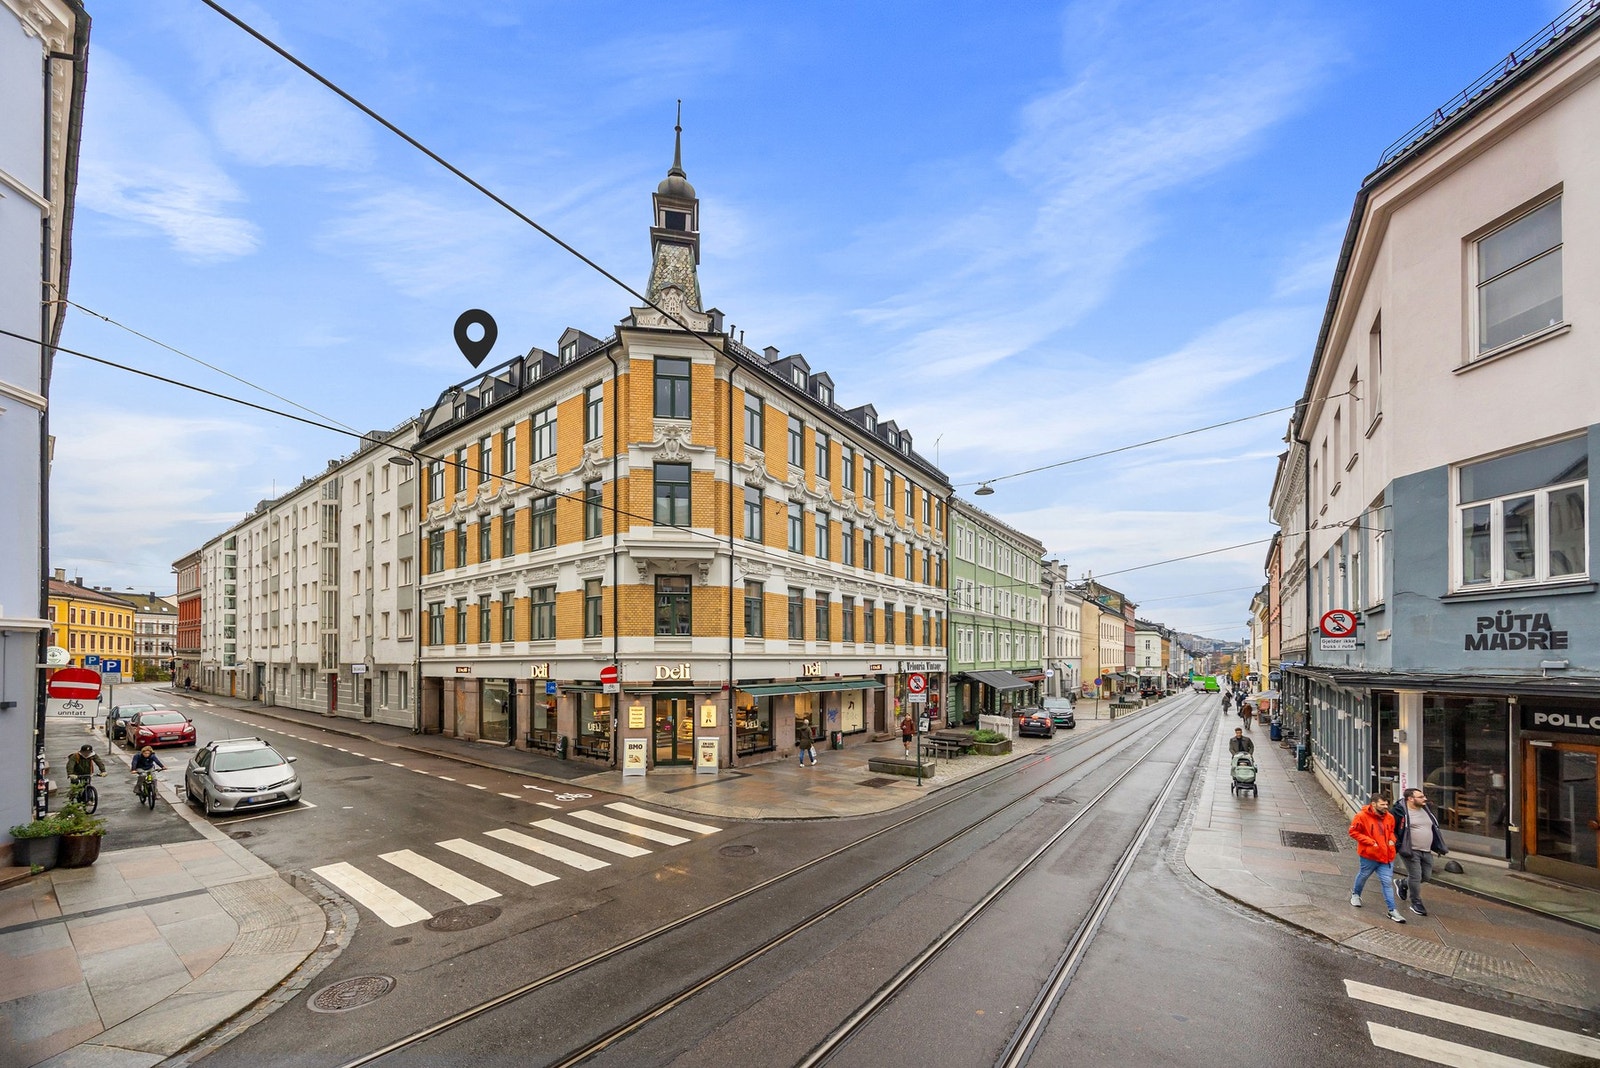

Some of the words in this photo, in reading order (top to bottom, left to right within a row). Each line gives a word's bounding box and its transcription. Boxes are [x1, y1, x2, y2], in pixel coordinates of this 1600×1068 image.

[1477, 609, 1552, 633] PÜTA
[1464, 631, 1568, 651] MADRE
[88, 656, 97, 664] P
[106, 661, 117, 672] P
[530, 663, 550, 678] Deli
[655, 662, 692, 680] Deli
[803, 661, 822, 677] Deli
